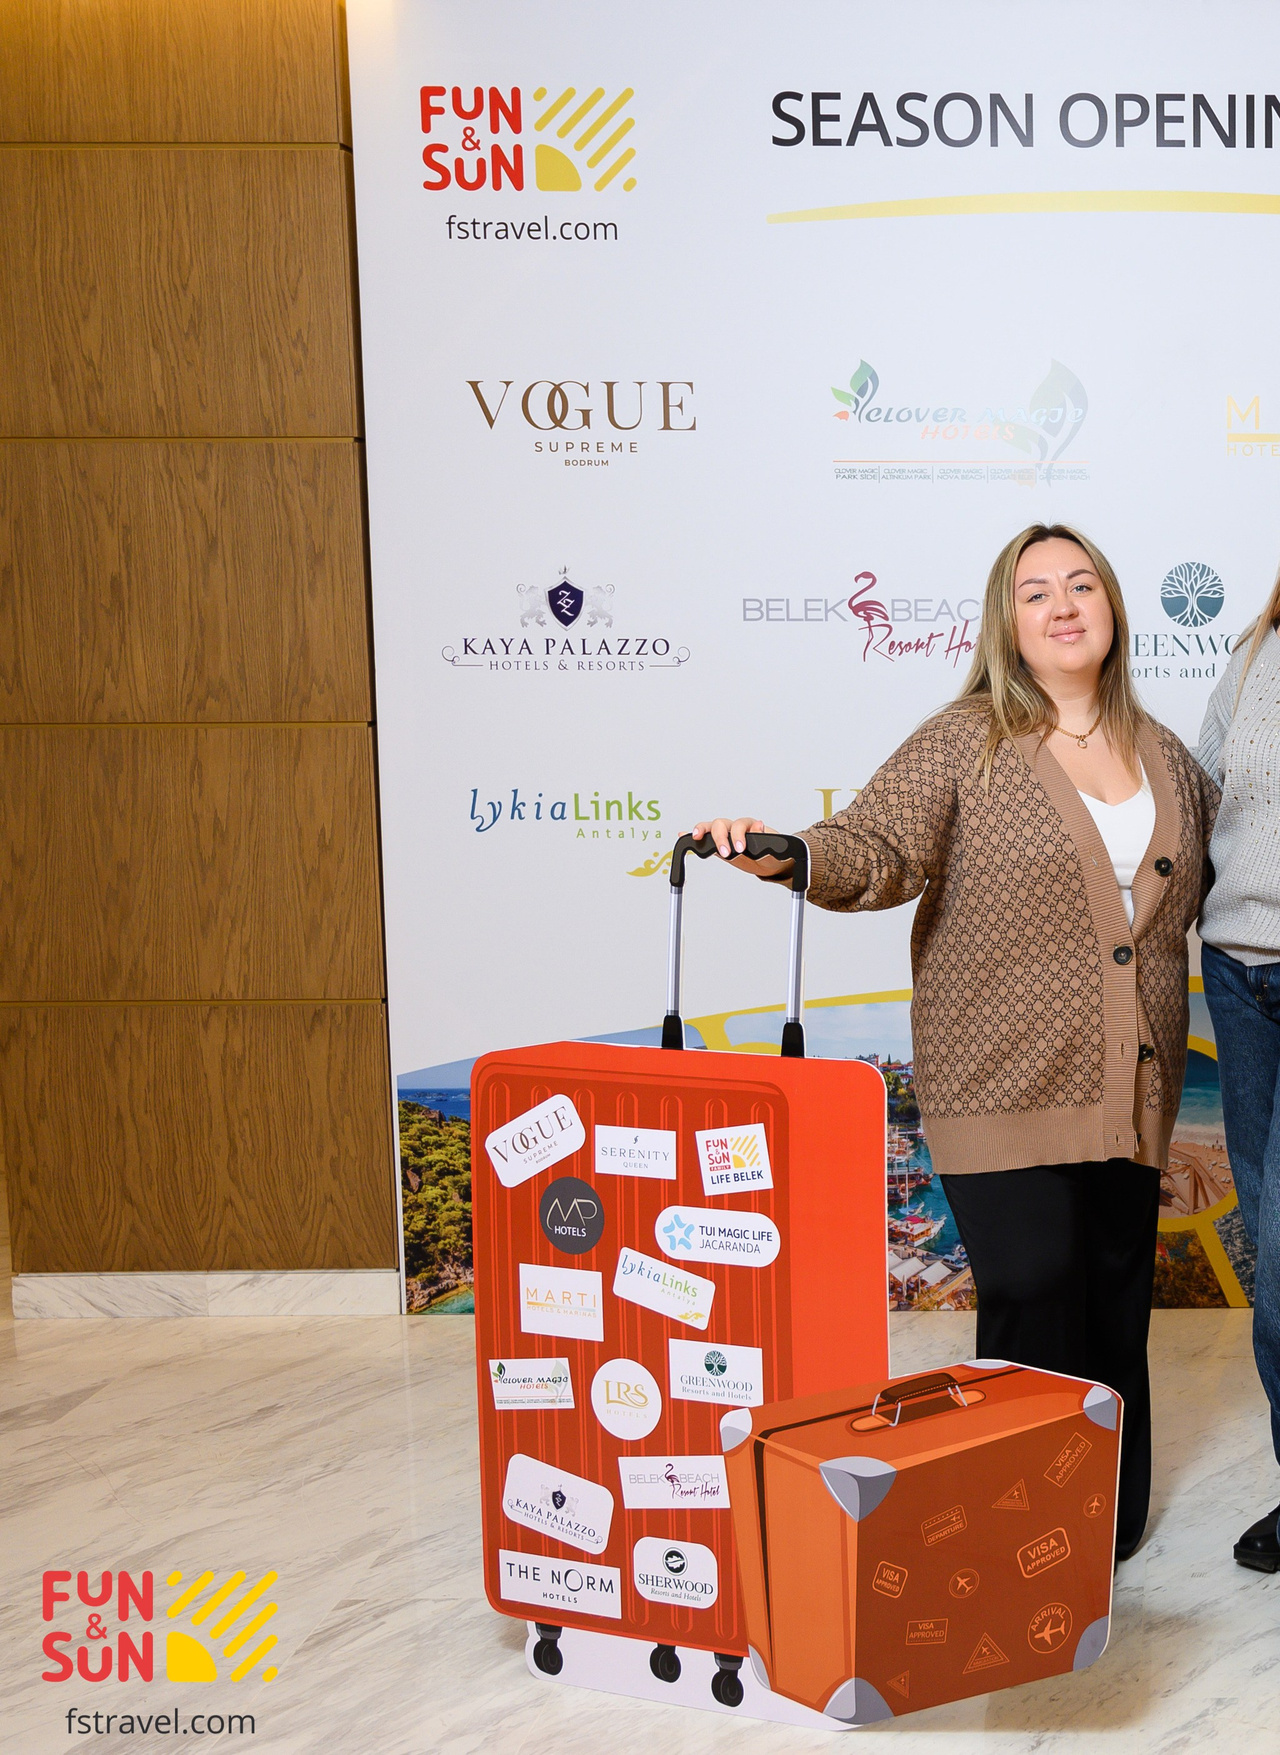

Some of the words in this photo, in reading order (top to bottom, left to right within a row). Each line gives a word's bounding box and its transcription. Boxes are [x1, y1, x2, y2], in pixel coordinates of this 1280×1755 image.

[420, 86, 522, 134] FUN
[771, 90, 1033, 149] SEASON
[461, 126, 481, 151] &
[422, 143, 524, 191] SUN
[446, 215, 618, 240] fstravel.com
[465, 380, 697, 431] VOGUE
[864, 406, 967, 424] CLOVER
[976, 406, 1084, 424] MAGIC
[534, 441, 638, 453] SUPREME
[564, 459, 609, 467] BODRUM
[742, 598, 849, 622] BELEK
[891, 599, 981, 622] BEAC
[462, 637, 534, 656] KAYA
[544, 637, 670, 656] PALAZZO
[858, 623, 945, 662] Resort
[489, 660, 549, 671] HOTELS
[557, 659, 569, 671] &
[577, 660, 645, 672] RESORTS
[1179, 663, 1216, 678] and
[576, 827, 662, 841] Antalya
[492, 1106, 573, 1163] VOGUE
[523, 1140, 558, 1164] SUPREME
[600, 1146, 670, 1162] SERENITY
[705, 1138, 728, 1152] FUN
[622, 1161, 649, 1169] QUEEN
[707, 1151, 731, 1166] SUN
[710, 1173, 731, 1185] LIFE
[733, 1169, 764, 1183] BELEK
[554, 1225, 587, 1237] HOTELS
[698, 1225, 716, 1237] TUI
[717, 1227, 750, 1240] MAGIC
[752, 1230, 773, 1242] LIFE
[699, 1238, 761, 1254] JACARANDA
[526, 1286, 596, 1308] MARTI
[660, 1288, 696, 1306] Antalya
[536, 1376, 569, 1384] MAGIC
[680, 1374, 753, 1393] GREENWOOD
[603, 1379, 649, 1409] LRS
[682, 1386, 710, 1396] Resorts
[728, 1390, 752, 1401] Hotels
[606, 1408, 648, 1419] HOTELS
[1055, 1449, 1072, 1467] VISA
[1055, 1441, 1086, 1482] APPROVED
[629, 1474, 666, 1484] BELEK
[680, 1473, 720, 1483] BEACH
[700, 1482, 720, 1501] Hotel
[515, 1498, 543, 1517] KAYA
[546, 1511, 596, 1538] PALAZZO
[524, 1511, 548, 1526] HOTELS
[557, 1525, 584, 1541] RESORTS
[927, 1521, 964, 1544] DEPARTURE
[1027, 1537, 1059, 1560] VISA
[1026, 1546, 1066, 1572] APPROVED
[506, 1562, 541, 1582] THE
[551, 1569, 614, 1594] NORM
[638, 1573, 714, 1595] SHERWOOD
[882, 1567, 900, 1584] VISA
[650, 1588, 670, 1597] Resorts
[671, 1591, 683, 1599] and
[875, 1578, 900, 1592] APPROVED
[542, 1592, 578, 1604] HOTELS
[918, 1622, 934, 1630] VISA
[1030, 1606, 1066, 1632] ARRIVAL
[909, 1630, 945, 1639] APPROVED
